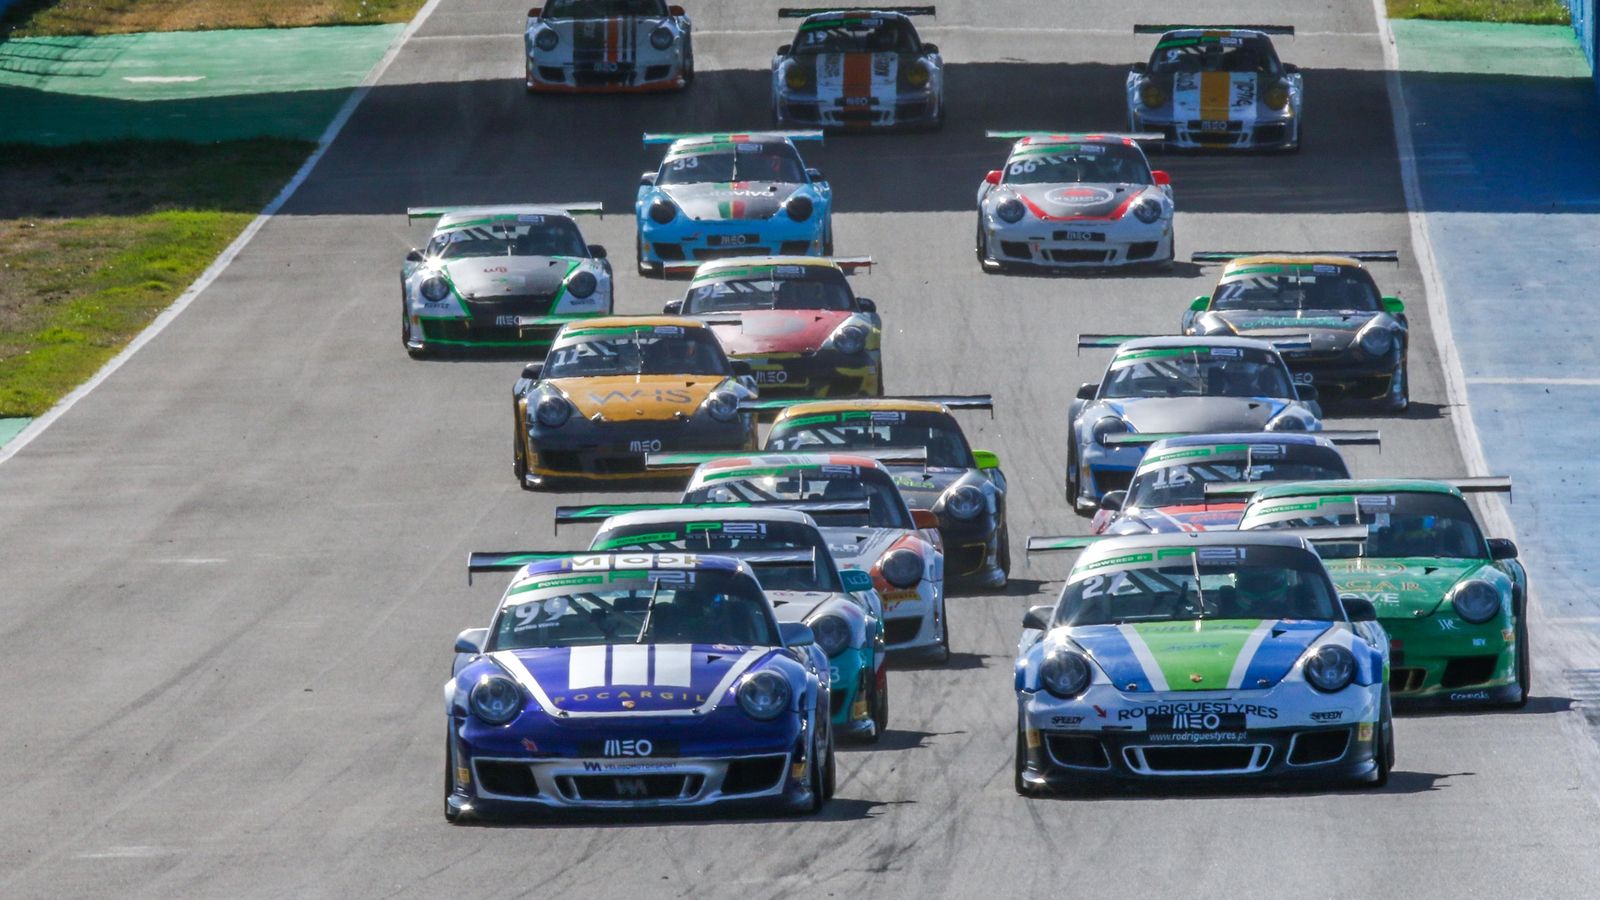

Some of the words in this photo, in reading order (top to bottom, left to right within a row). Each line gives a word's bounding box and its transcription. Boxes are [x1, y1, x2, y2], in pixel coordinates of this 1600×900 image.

[673, 157, 698, 170] 33
[1010, 160, 1036, 176] 66
[720, 234, 746, 245] MEO
[755, 371, 788, 383] MEO
[630, 439, 662, 452] MEO
[685, 521, 767, 534] P21
[515, 596, 570, 627] 99
[553, 689, 706, 706] POCARGIL
[1117, 701, 1279, 722] RODRIGUESTYRES
[1172, 713, 1220, 730] MEO
[1149, 730, 1248, 743] www.rodriguestyres.pt
[603, 739, 653, 757] MEO
